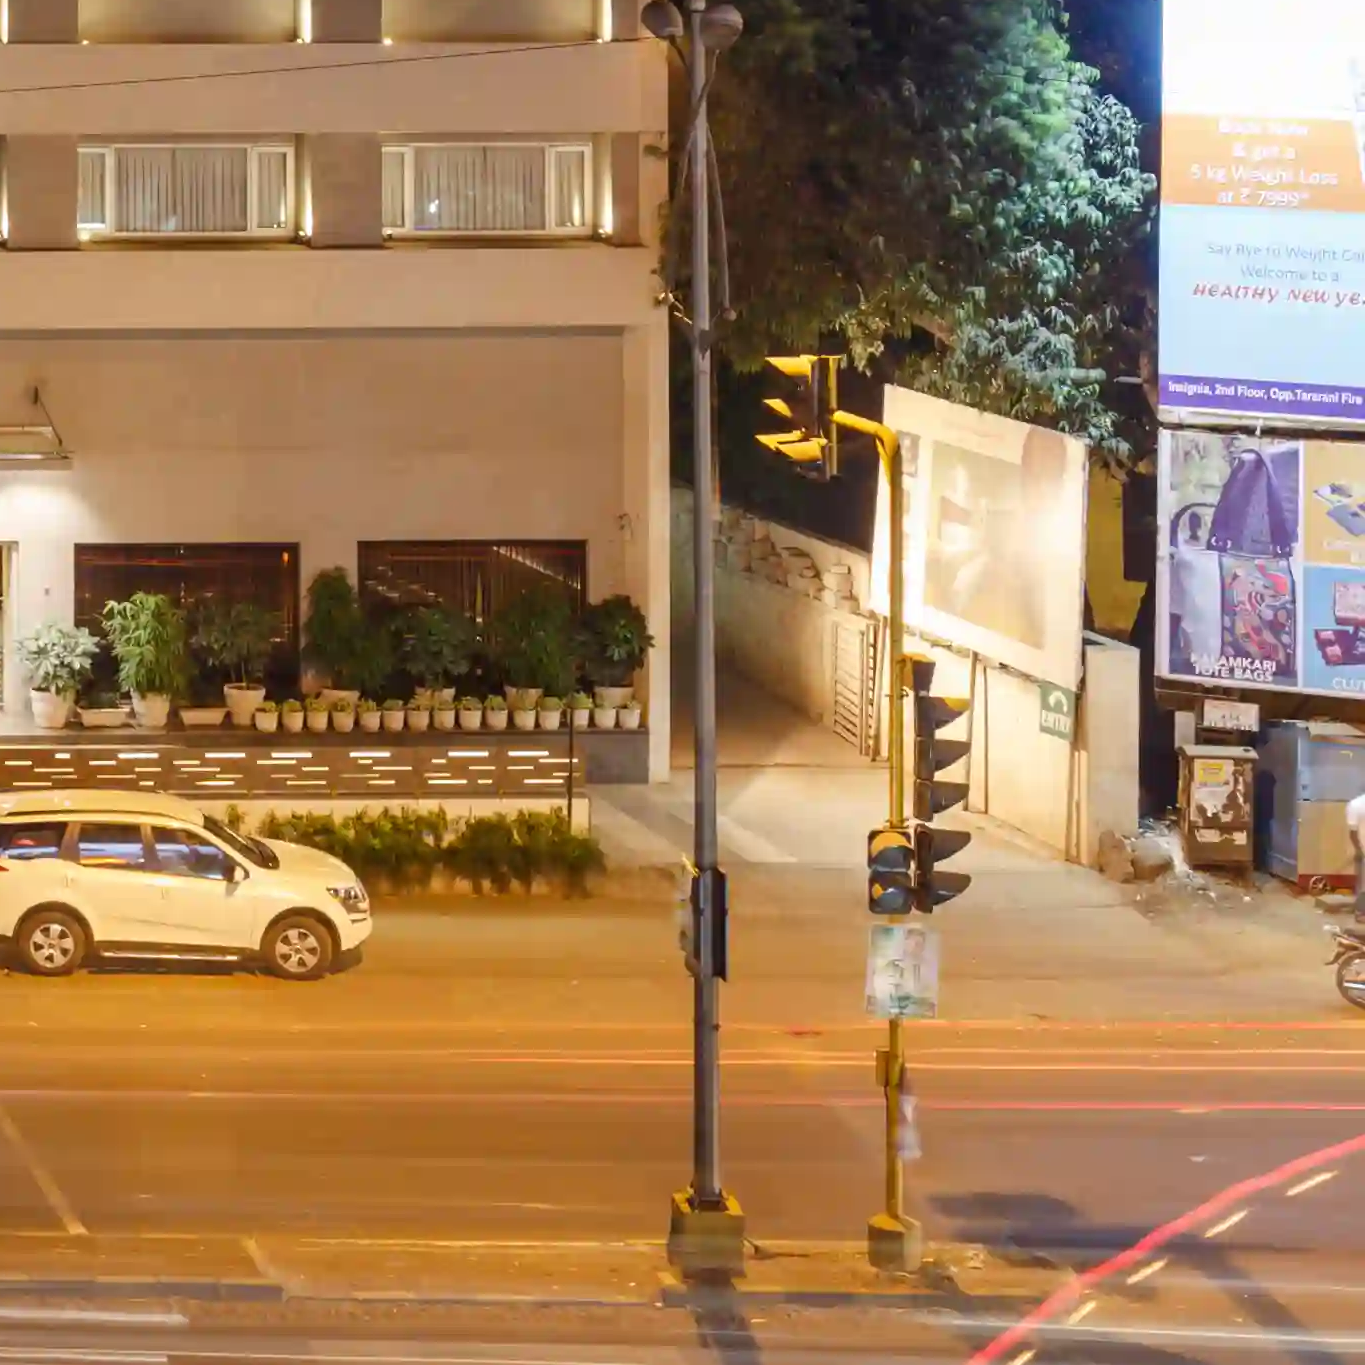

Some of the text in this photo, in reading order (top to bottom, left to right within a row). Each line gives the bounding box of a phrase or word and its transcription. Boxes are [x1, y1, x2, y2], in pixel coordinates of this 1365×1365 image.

[1206, 165, 1226, 183] kg
[1231, 165, 1294, 185] Weight
[1300, 167, 1337, 185] Loss
[1207, 242, 1232, 260] Say
[1285, 245, 1337, 265] Weight
[1240, 264, 1342, 282] Welcome to a
[1168, 380, 1213, 396] Insignia,
[1215, 383, 1235, 396] 2nd
[1237, 385, 1268, 401] Floor,
[1341, 392, 1364, 406] Fire
[1193, 664, 1274, 682] TOTE BAGS
